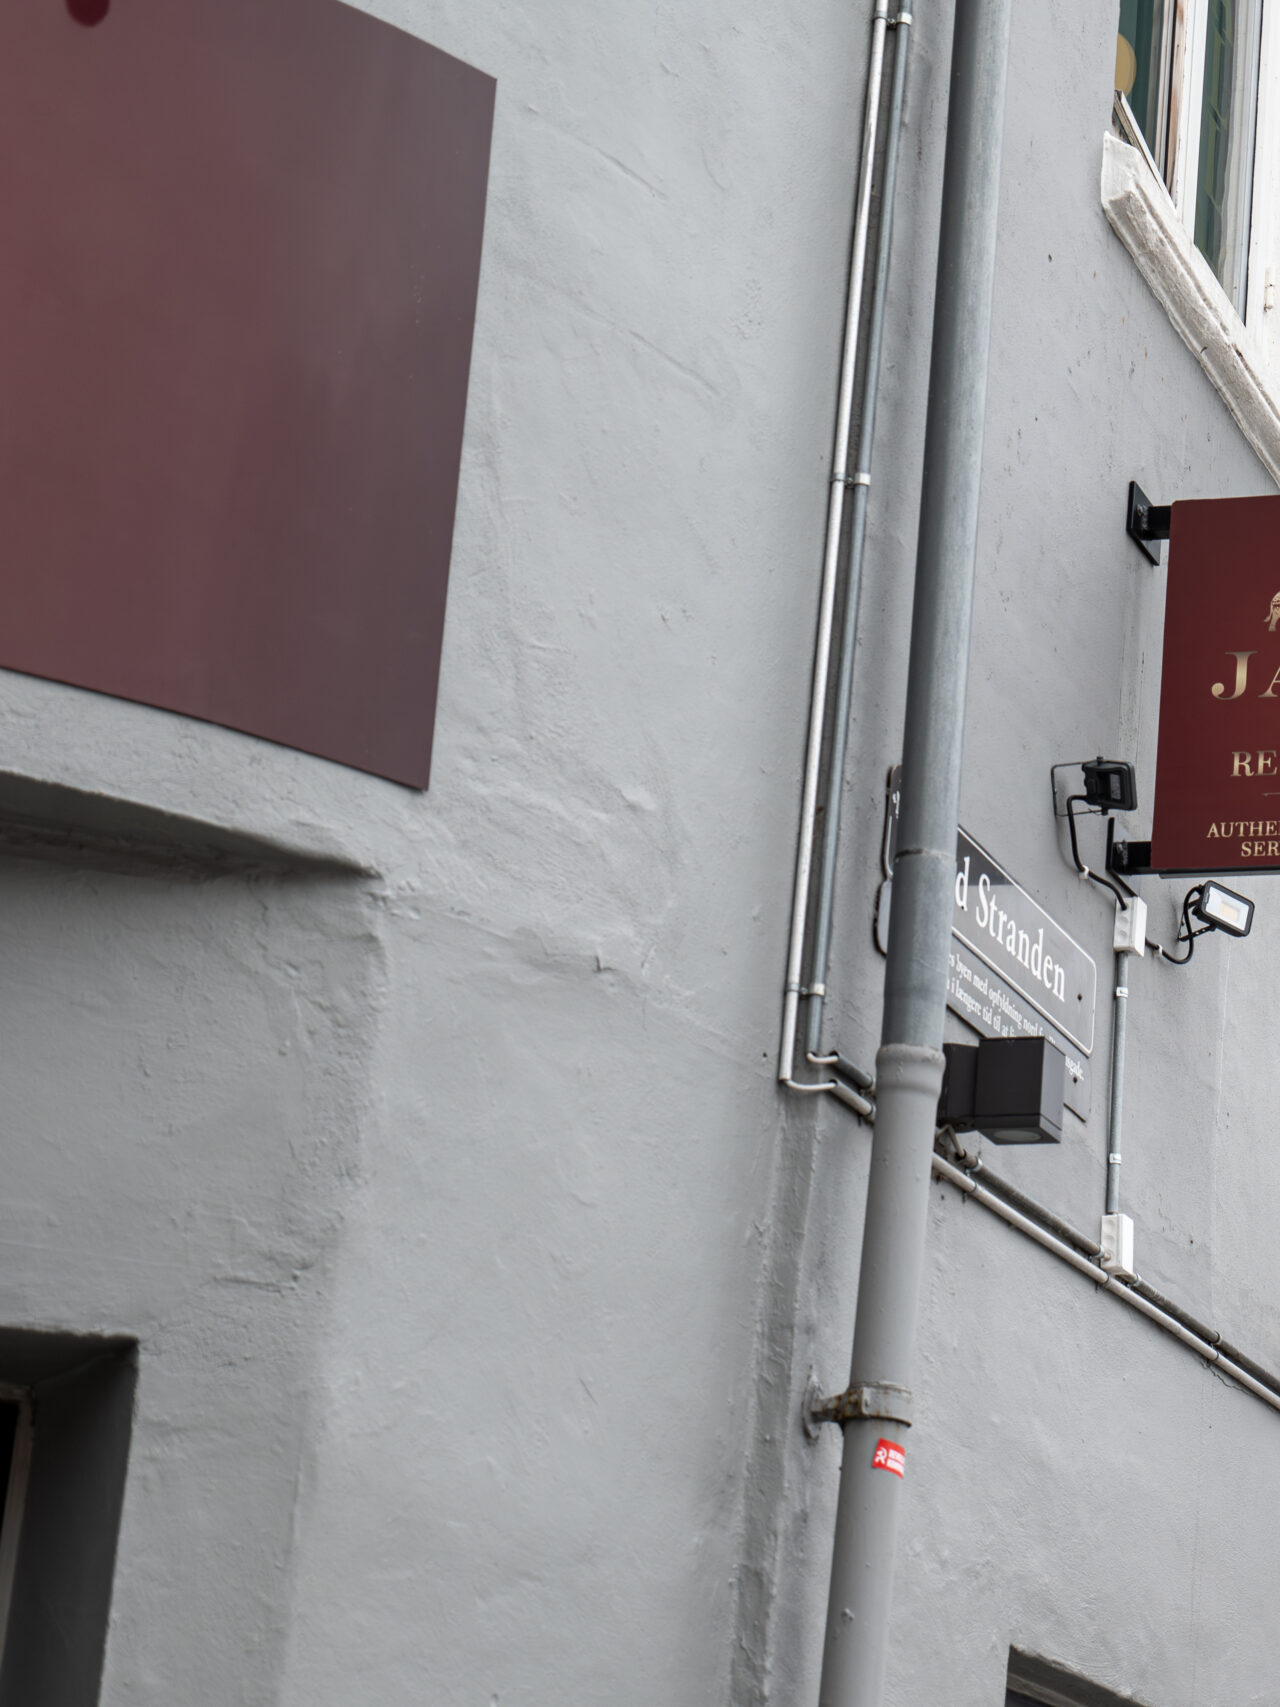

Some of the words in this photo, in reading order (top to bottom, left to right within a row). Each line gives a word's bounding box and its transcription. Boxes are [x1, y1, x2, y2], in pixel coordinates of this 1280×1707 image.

[976, 873, 1065, 1003] Stranden
[955, 953, 972, 982] byen
[973, 974, 988, 995] med
[982, 1006, 993, 1025] tid
